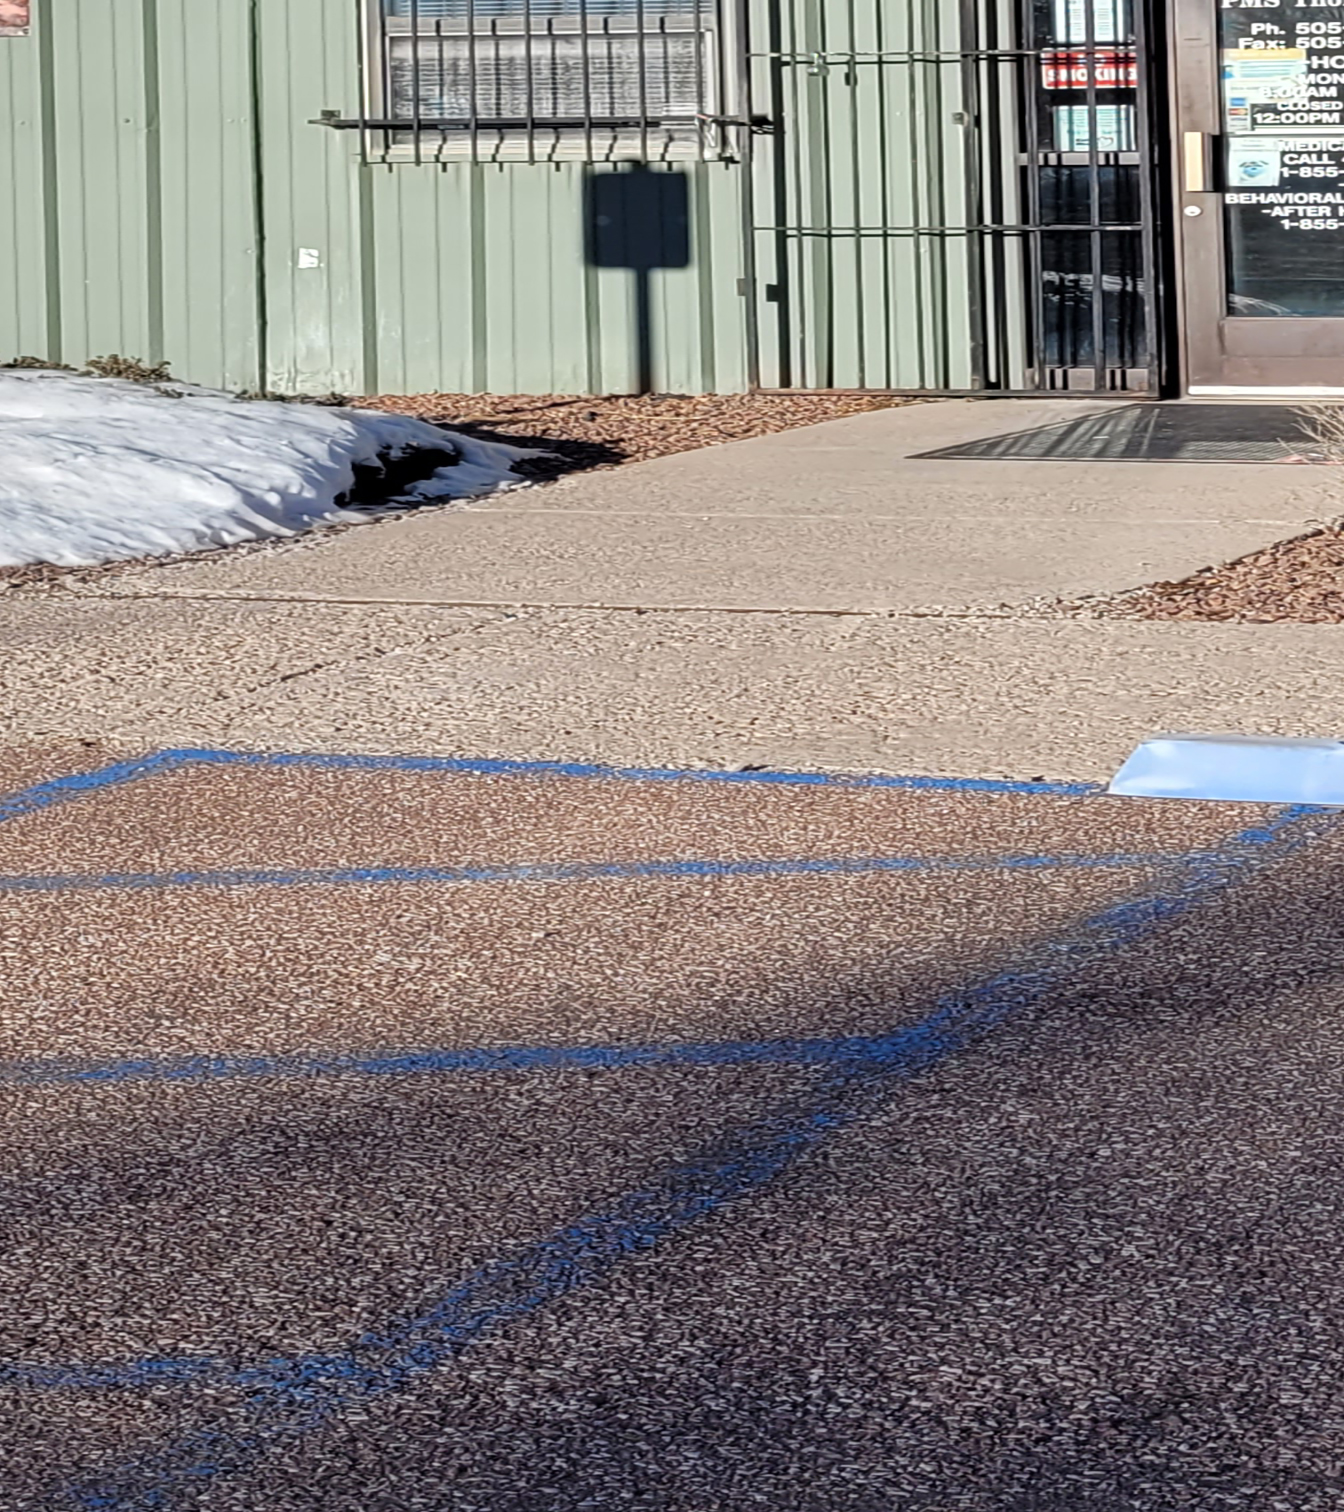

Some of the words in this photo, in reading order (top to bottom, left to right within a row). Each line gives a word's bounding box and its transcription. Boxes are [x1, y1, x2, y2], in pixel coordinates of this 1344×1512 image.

[1250, 22, 1286, 36] Ph.
[1238, 37, 1286, 50] Fax:
[1276, 101, 1344, 111] CLOSED
[1253, 112, 1340, 124] 12:00PM
[1282, 153, 1336, 165] CALL
[1260, 205, 1332, 217] -AFTER
